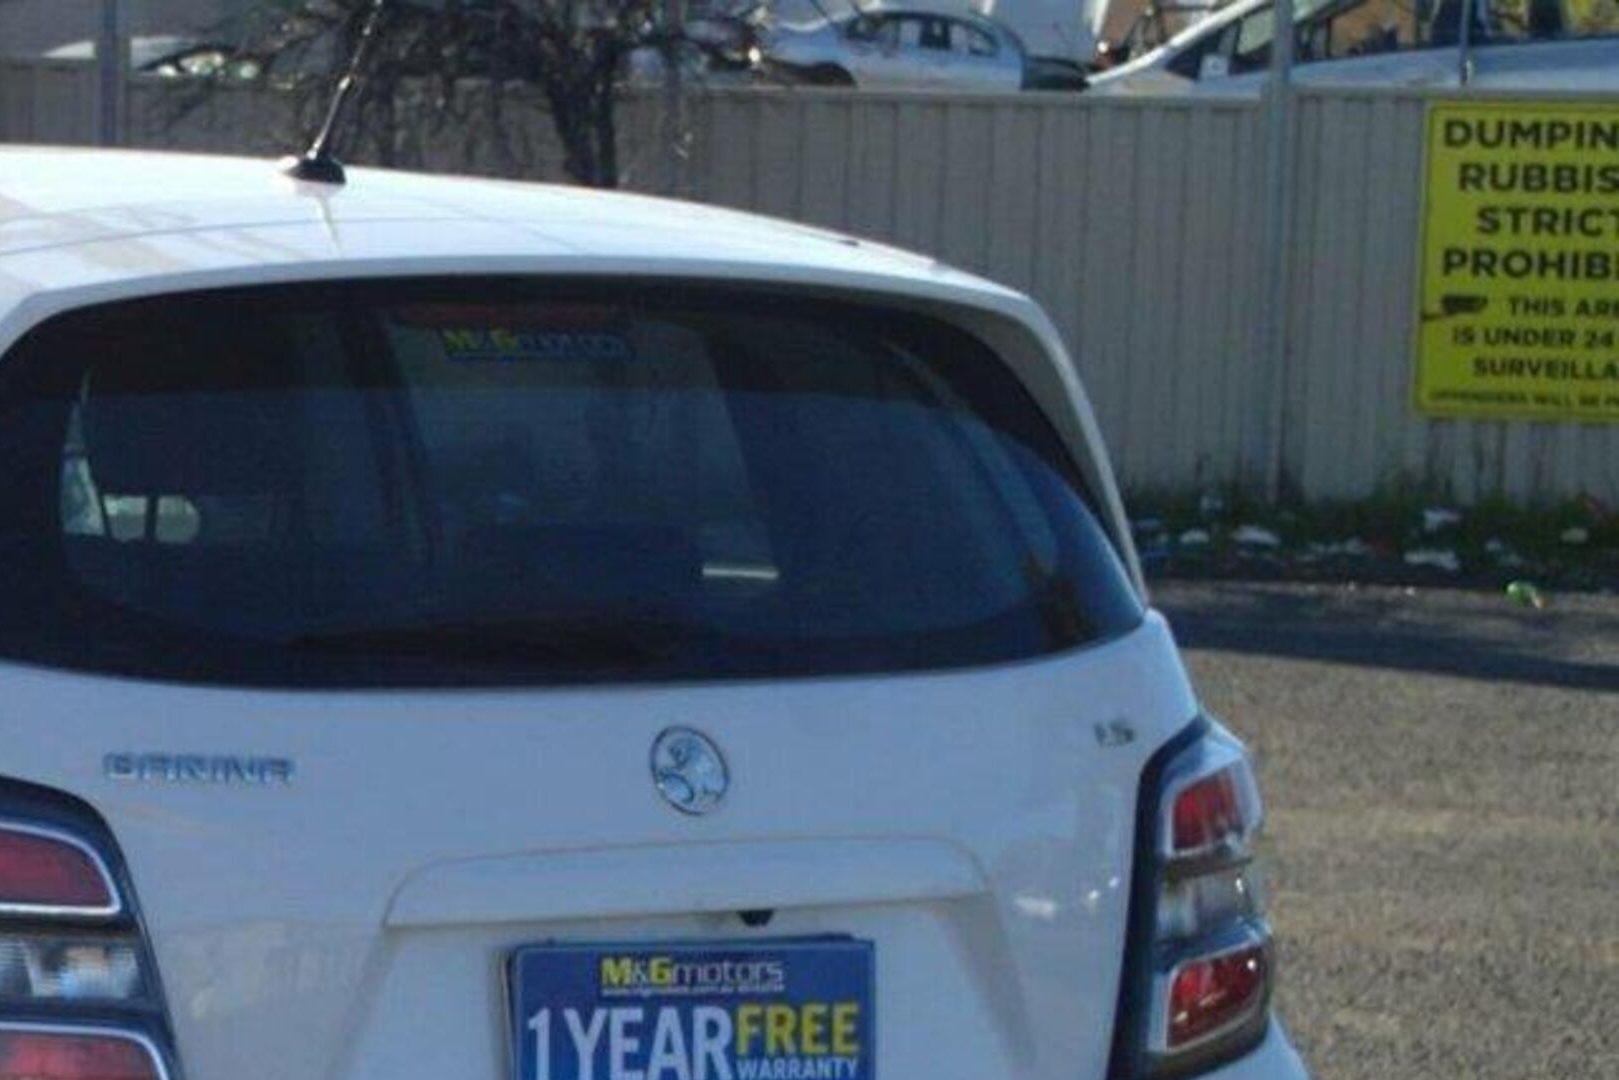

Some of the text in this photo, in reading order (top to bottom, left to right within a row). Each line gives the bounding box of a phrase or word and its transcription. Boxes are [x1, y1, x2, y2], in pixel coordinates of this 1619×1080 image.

[1444, 119, 1619, 150] DUMPIN
[1508, 295, 1566, 318] THIS
[1453, 326, 1613, 350] IS UNDER 24
[735, 1003, 860, 1055] FREE
